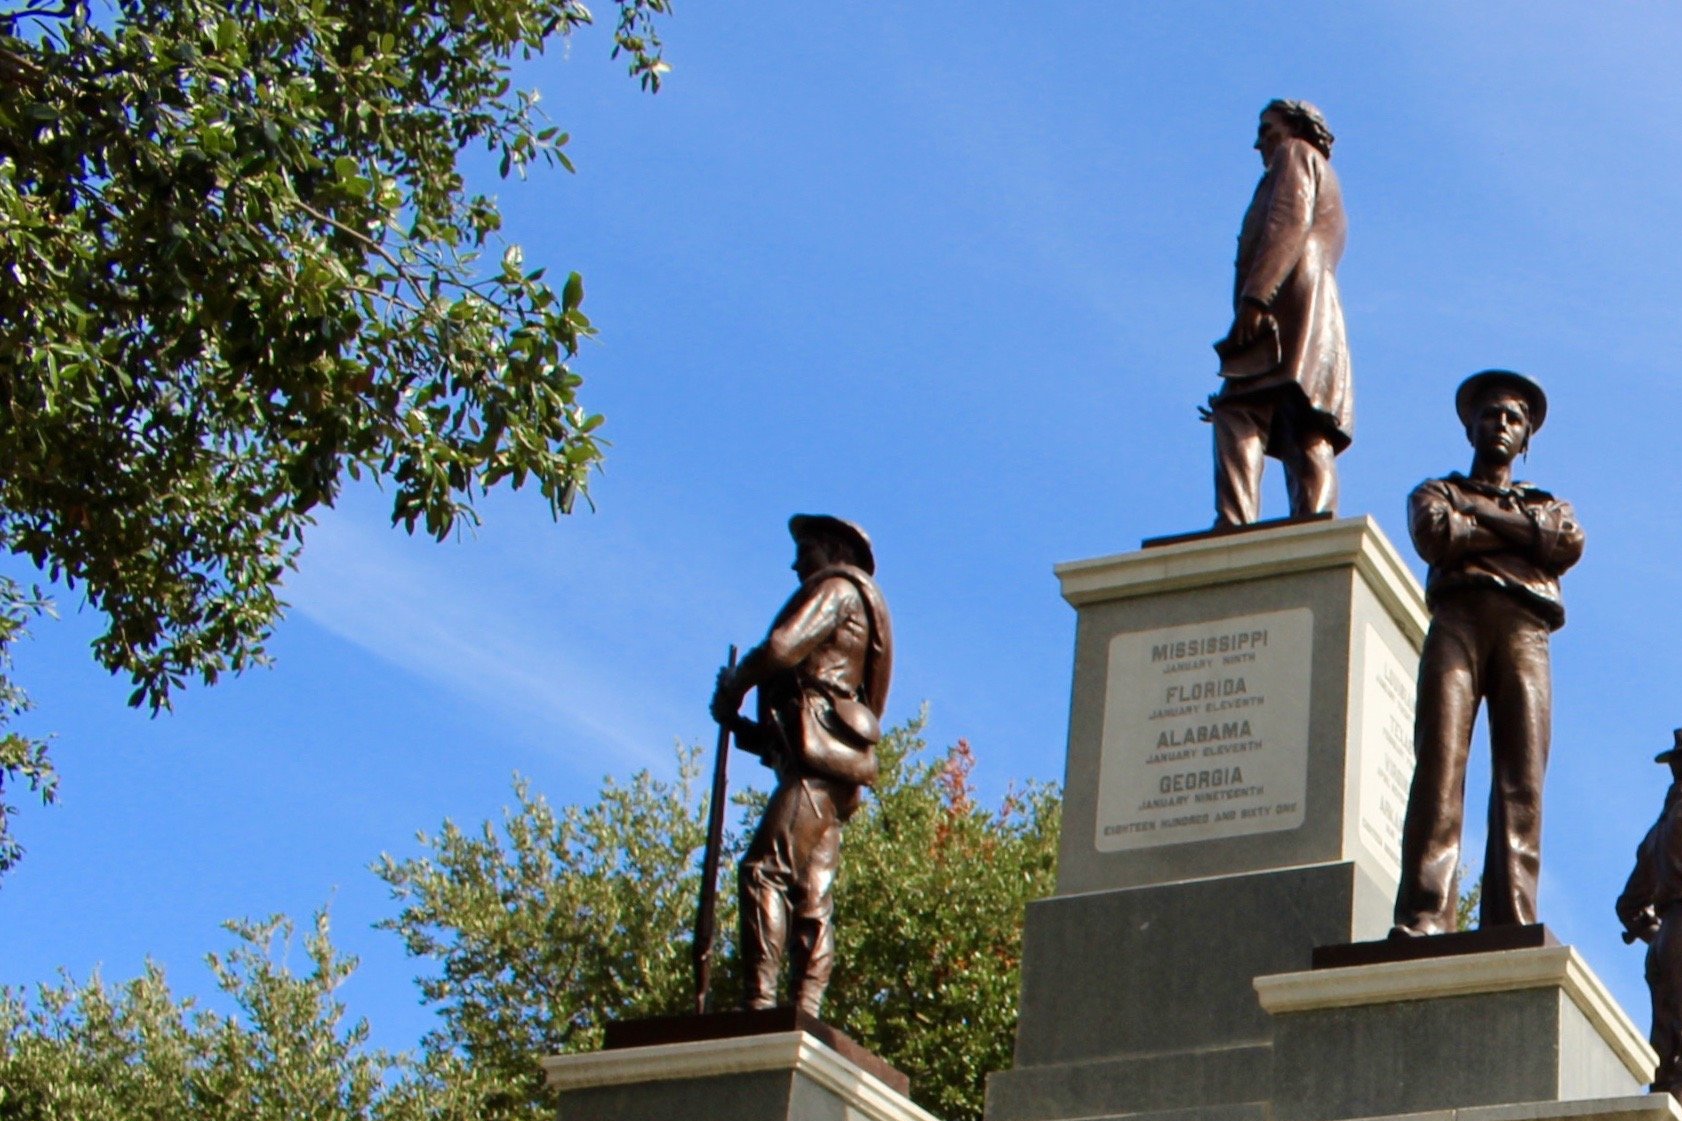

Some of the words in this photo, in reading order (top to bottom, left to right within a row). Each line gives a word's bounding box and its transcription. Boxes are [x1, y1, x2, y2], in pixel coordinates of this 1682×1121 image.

[1151, 629, 1268, 662] MISSISSIPPI
[1163, 659, 1213, 674] JANUARY
[1222, 652, 1255, 666] NINTH
[1166, 677, 1247, 703] FLORIDA
[1149, 704, 1200, 720] JANUARY
[1205, 696, 1265, 712] ELEVENTH
[1156, 720, 1252, 749] ALABAMA
[1146, 749, 1197, 765] JANUARY
[1203, 740, 1263, 757] ELEVENTH
[1160, 766, 1243, 794] GEORGIA
[1138, 795, 1189, 811] JANUARY
[1195, 785, 1264, 803] NINETEENTH
[1104, 820, 1156, 836] EIGHTEEN
[1161, 813, 1209, 828] HUNDRED
[1214, 811, 1236, 823] AND
[1240, 804, 1271, 819] SIXTY
[1276, 802, 1297, 815] ONE
